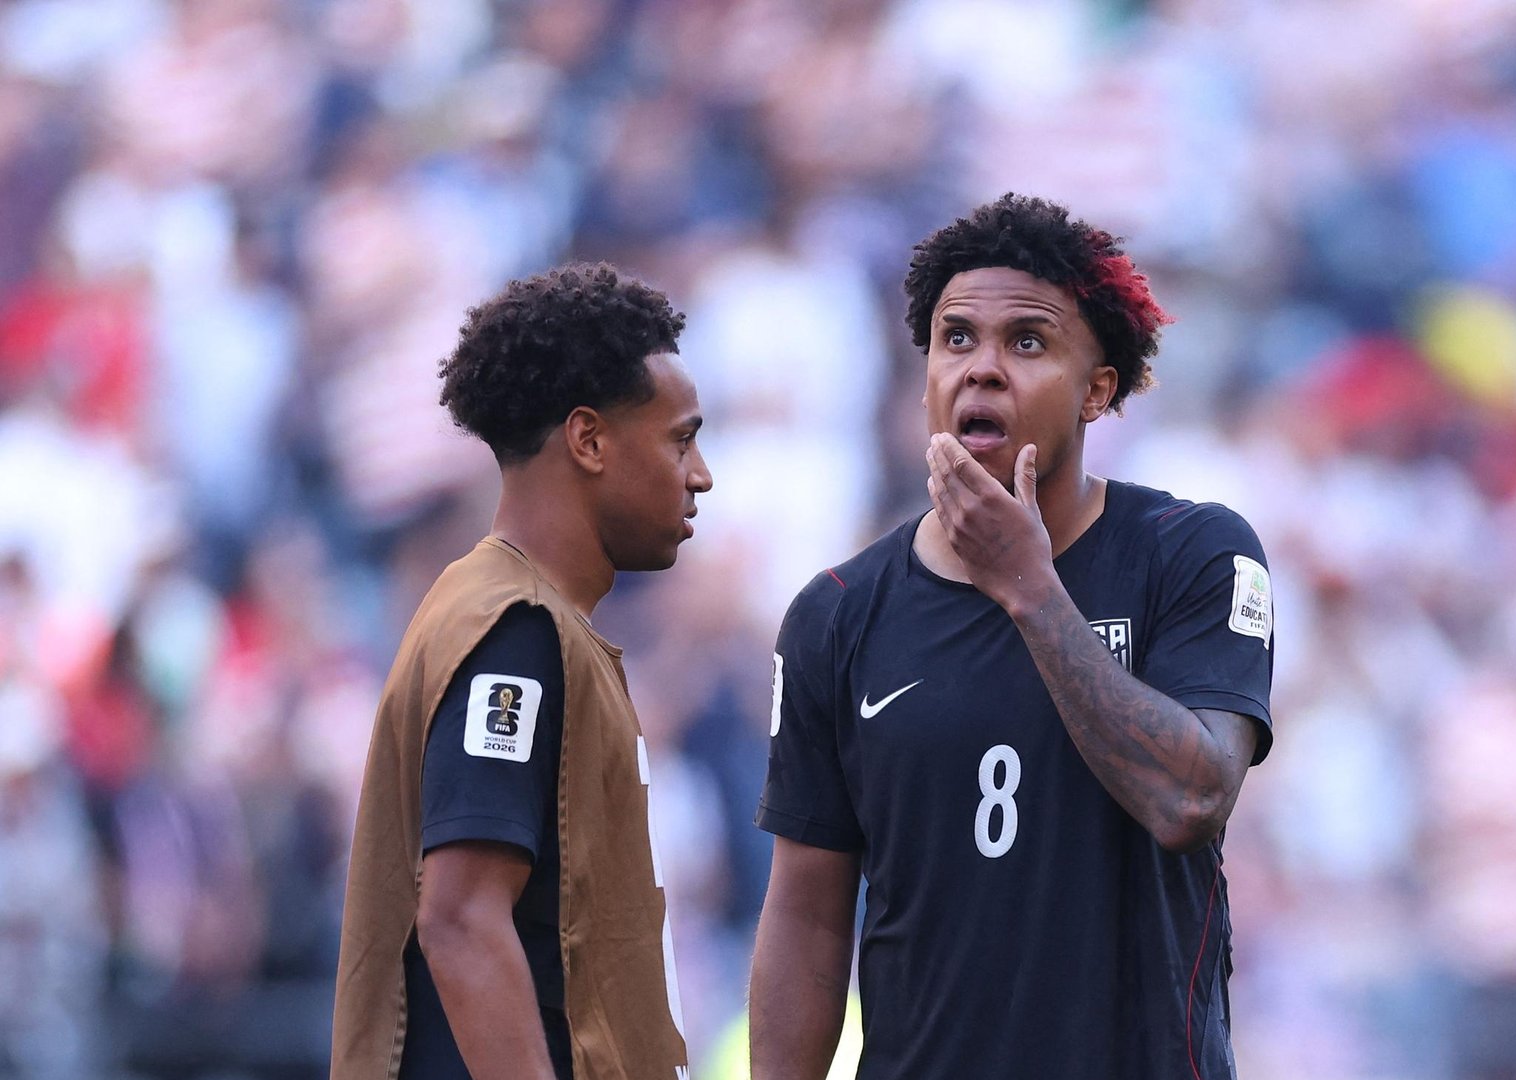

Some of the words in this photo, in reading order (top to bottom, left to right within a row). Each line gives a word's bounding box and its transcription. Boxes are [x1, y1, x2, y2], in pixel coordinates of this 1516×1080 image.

[1241, 605, 1267, 622] EDUCAT
[494, 723, 511, 733] FIFA
[483, 742, 516, 753] 2026
[974, 744, 1021, 858] 8
